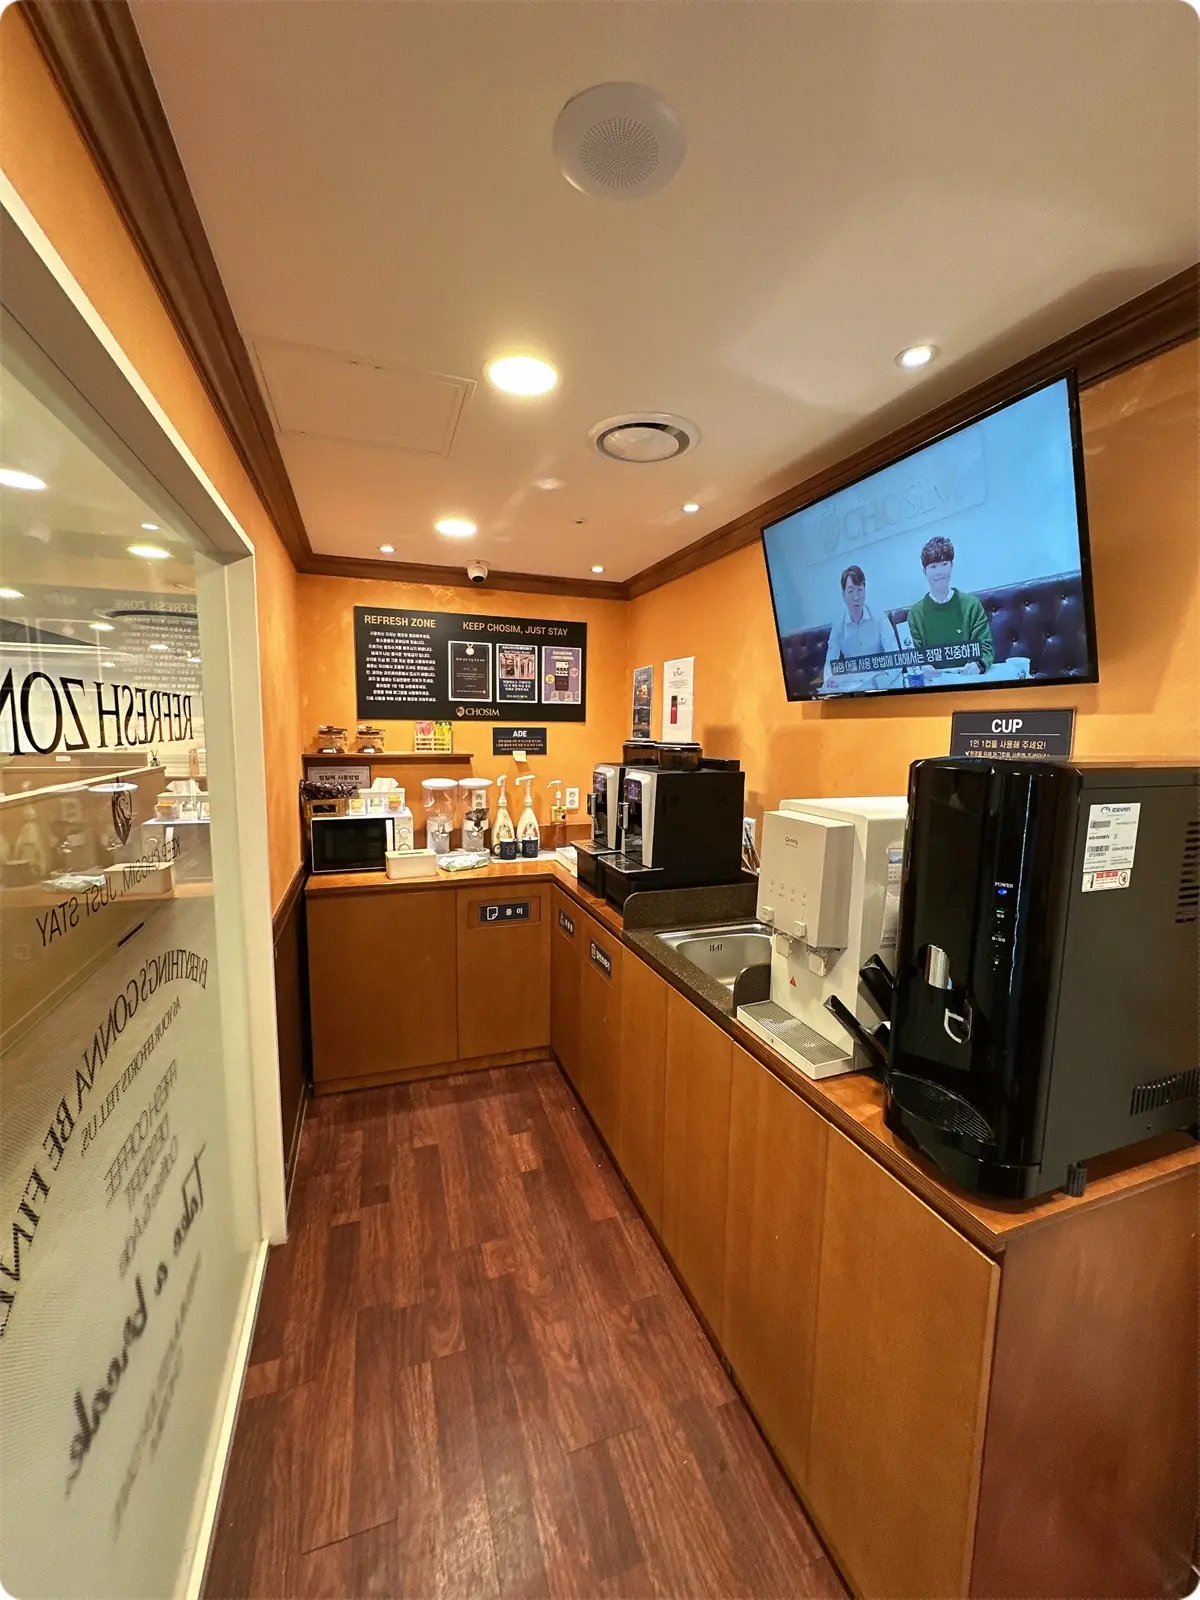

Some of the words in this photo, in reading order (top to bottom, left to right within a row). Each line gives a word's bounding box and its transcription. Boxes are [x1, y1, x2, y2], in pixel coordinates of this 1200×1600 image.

[364, 615, 408, 627] REFRESH
[411, 618, 436, 628] ZONE
[463, 621, 485, 631] KEEP
[487, 623, 523, 634] CHOSIM,
[525, 625, 546, 635] JUST
[548, 627, 568, 636] STAY
[858, 657, 871, 670] 사용
[871, 655, 894, 670] 방법에
[894, 651, 925, 666] 대해서는
[925, 648, 943, 662] 정말
[944, 643, 981, 660] 진중하게
[465, 707, 500, 717] CHOSIM
[991, 718, 1023, 733] CUP
[512, 730, 528, 738] ADE
[969, 739, 979, 748] 1인
[1000, 740, 1020, 749] 사용해
[1022, 740, 1047, 750] 주세요!
[994, 881, 1014, 889] POWER
